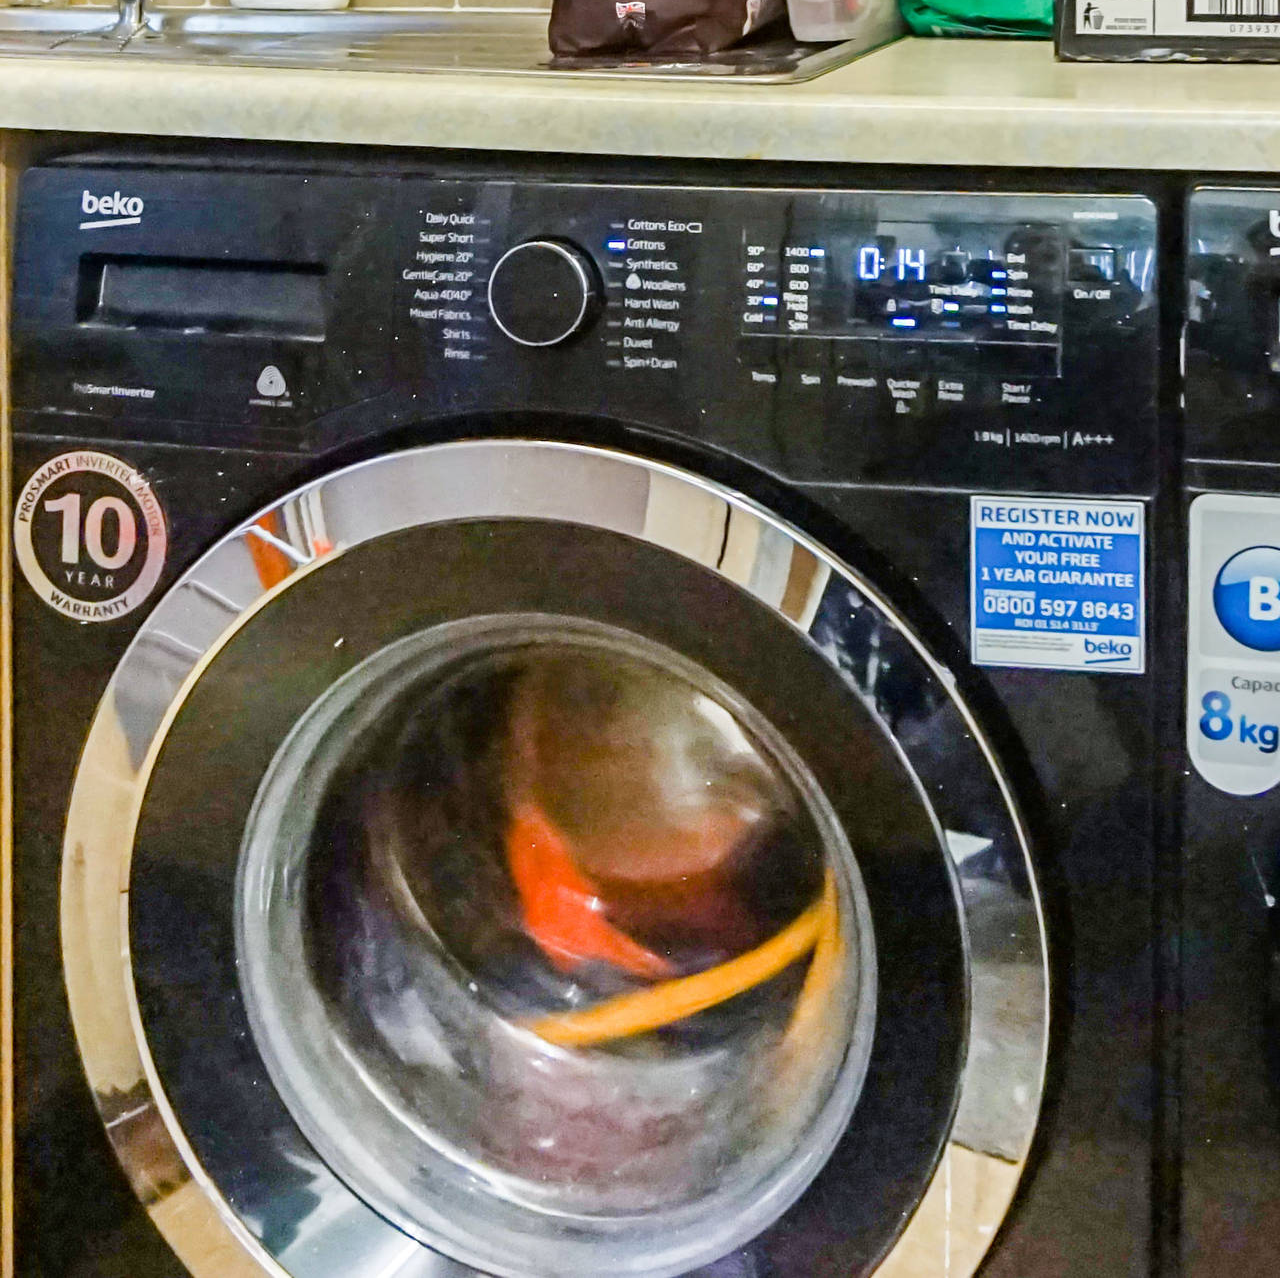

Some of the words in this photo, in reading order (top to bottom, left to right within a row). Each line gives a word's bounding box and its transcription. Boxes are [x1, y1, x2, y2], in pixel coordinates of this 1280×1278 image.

[81, 190, 144, 216] beko
[449, 213, 475, 226] Quick
[627, 218, 667, 231] Cottons
[668, 220, 686, 232] Eco
[447, 232, 474, 244] Short
[626, 238, 666, 251] Cottons
[785, 247, 810, 257] 1400
[626, 257, 678, 272] Synthetics
[859, 247, 925, 281] 0:14
[624, 298, 651, 309] Hand
[652, 298, 680, 310] Wash
[442, 328, 471, 340] Shirts
[444, 348, 471, 360] Rinse
[18, 457, 71, 523] PROSMART
[981, 506, 1080, 526] REGISTER
[1086, 511, 1135, 528] NOW
[44, 493, 136, 570] 10
[1002, 532, 1036, 546] AND
[1038, 533, 1113, 550] ACTIVATE
[1014, 550, 1058, 565] YOUR
[1060, 553, 1101, 568] FREE
[66, 571, 115, 589] YEAR
[981, 567, 991, 581] 1
[994, 568, 1036, 583] YEAR
[1038, 570, 1135, 588] GUARANTEE
[49, 590, 129, 618] WARRANTY
[983, 597, 1036, 615] 0800
[1040, 599, 1077, 617] 597
[1081, 601, 1135, 621] 8643
[1084, 638, 1132, 656] beko
